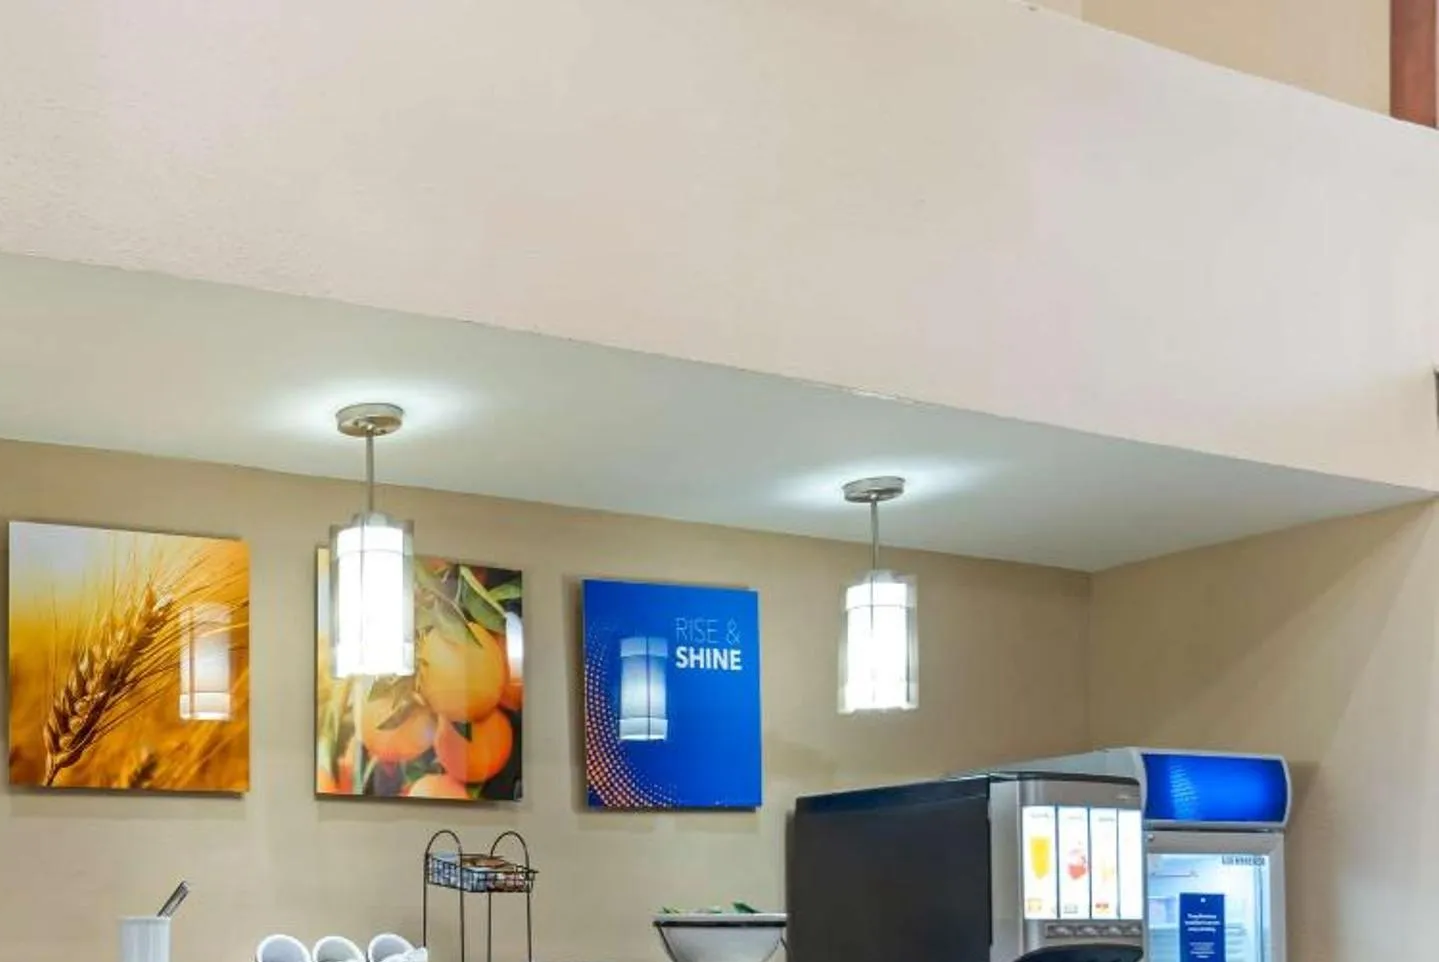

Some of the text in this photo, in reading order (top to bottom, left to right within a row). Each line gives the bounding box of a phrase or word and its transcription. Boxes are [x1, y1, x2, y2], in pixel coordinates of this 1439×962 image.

[675, 617, 741, 645] RISE &
[675, 646, 742, 671] SHINE
